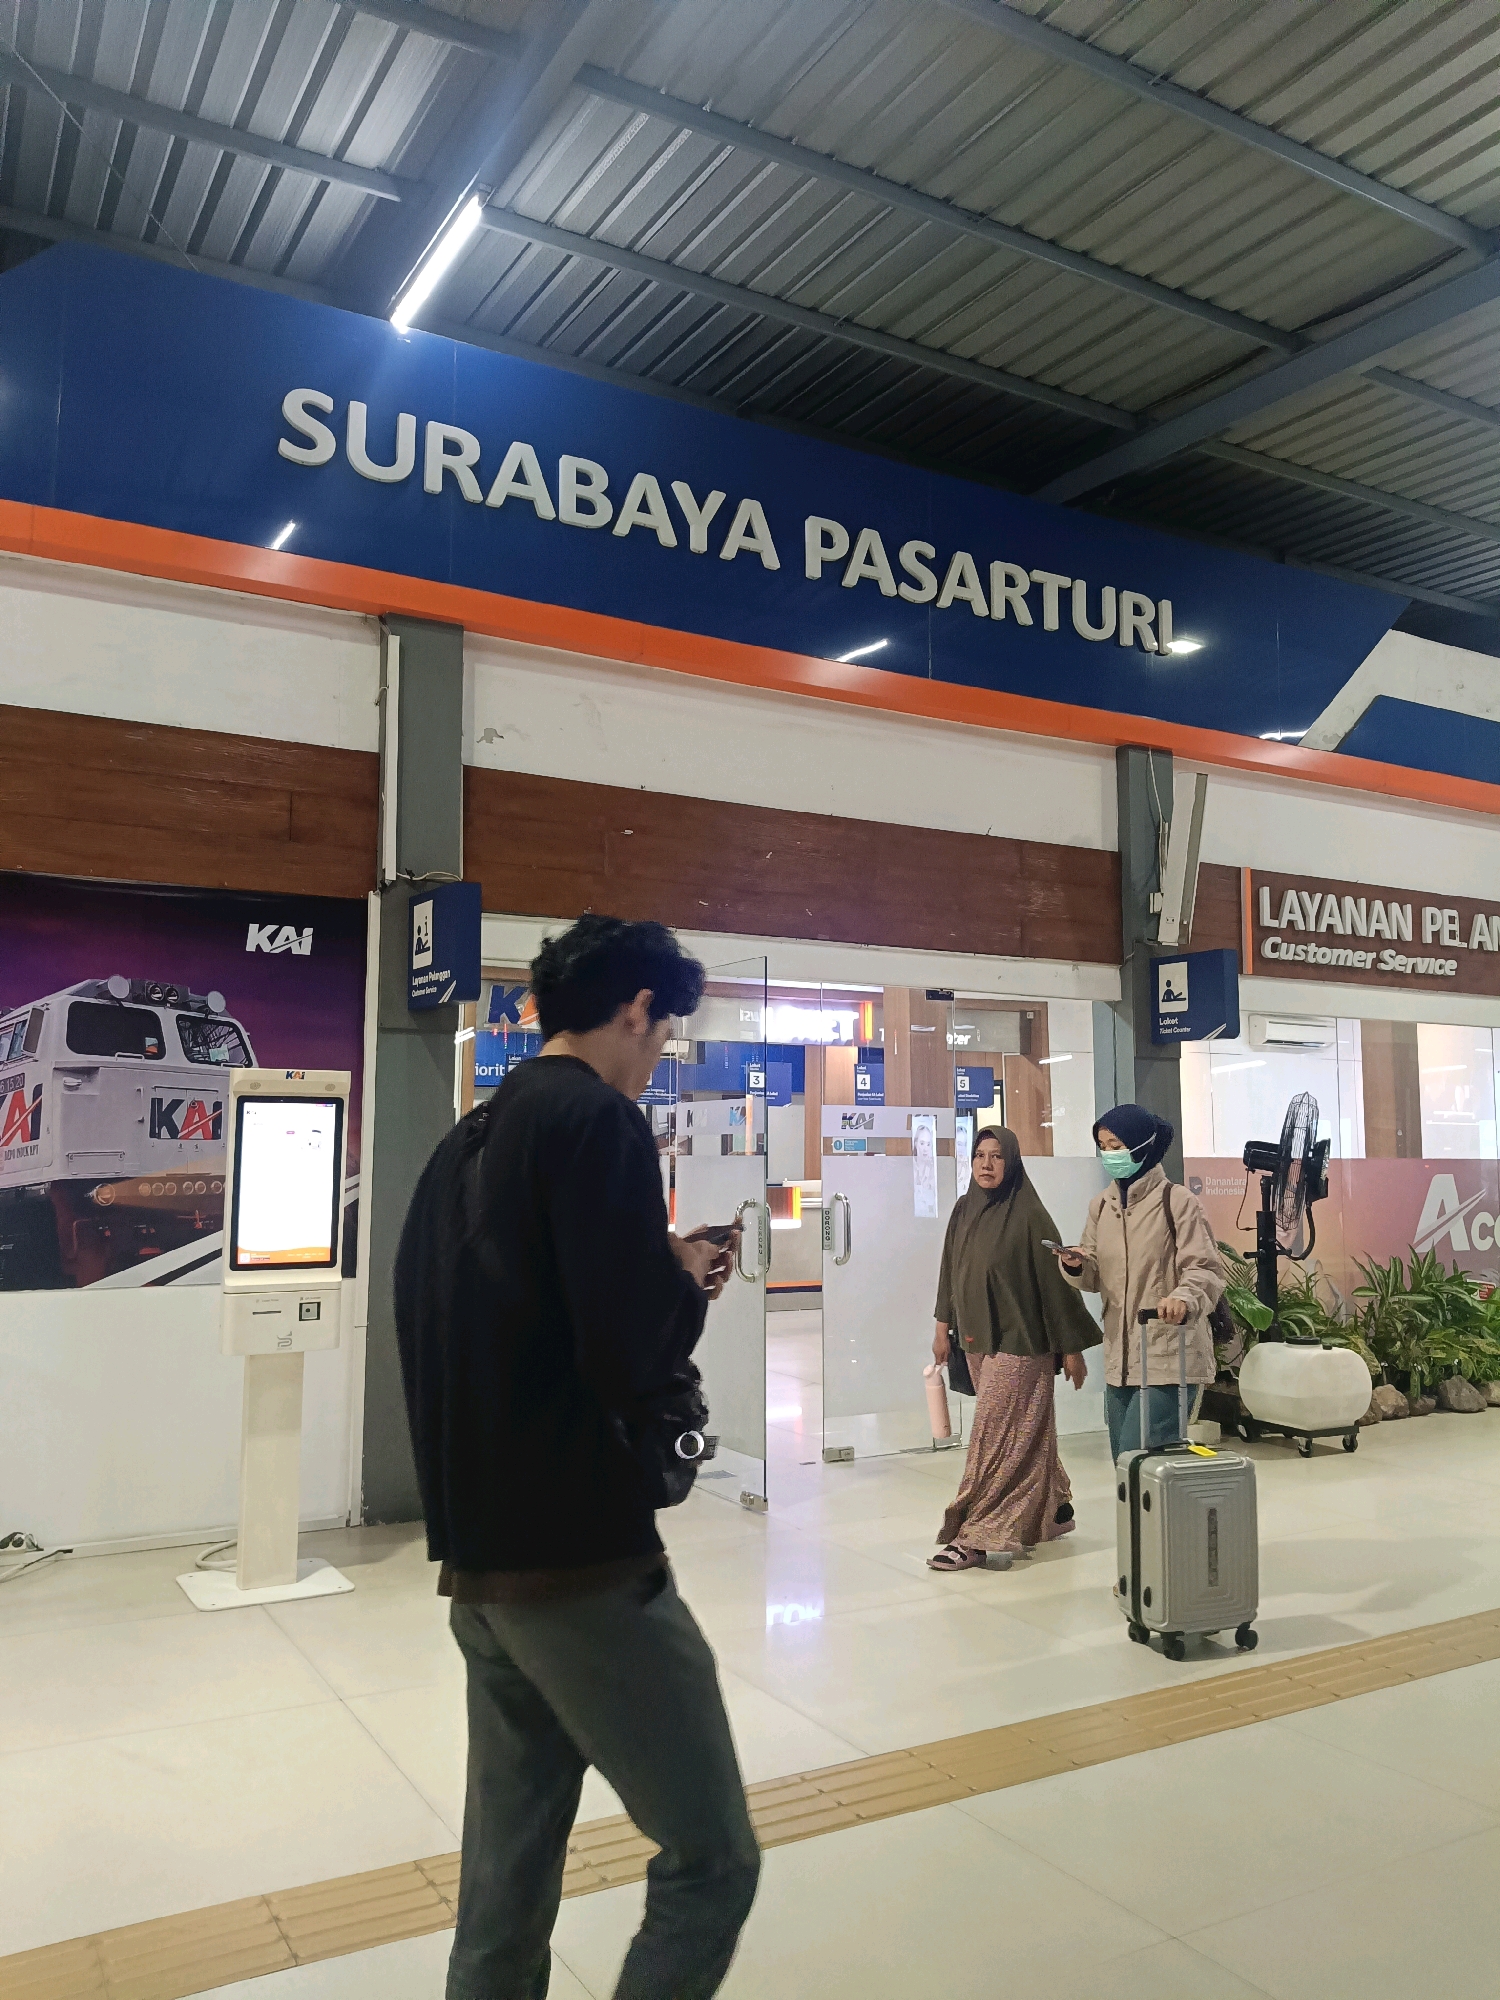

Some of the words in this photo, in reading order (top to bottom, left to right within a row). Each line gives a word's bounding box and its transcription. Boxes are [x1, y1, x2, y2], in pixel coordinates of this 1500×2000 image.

[277, 388, 781, 570] SURABAYA
[804, 515, 1174, 656] PASARTURI
[1259, 886, 1413, 942] LAYANAN
[245, 923, 314, 956] KAI
[1261, 936, 1376, 970] Customer
[1377, 948, 1458, 977] Service
[752, 1075, 761, 1086] 3
[860, 1077, 868, 1087] 4
[959, 1079, 966, 1089] 5
[0, 1083, 43, 1147] AI
[149, 1097, 223, 1140] KAI
[1205, 1176, 1248, 1186] Danantara
[1205, 1186, 1246, 1196] Indonesia
